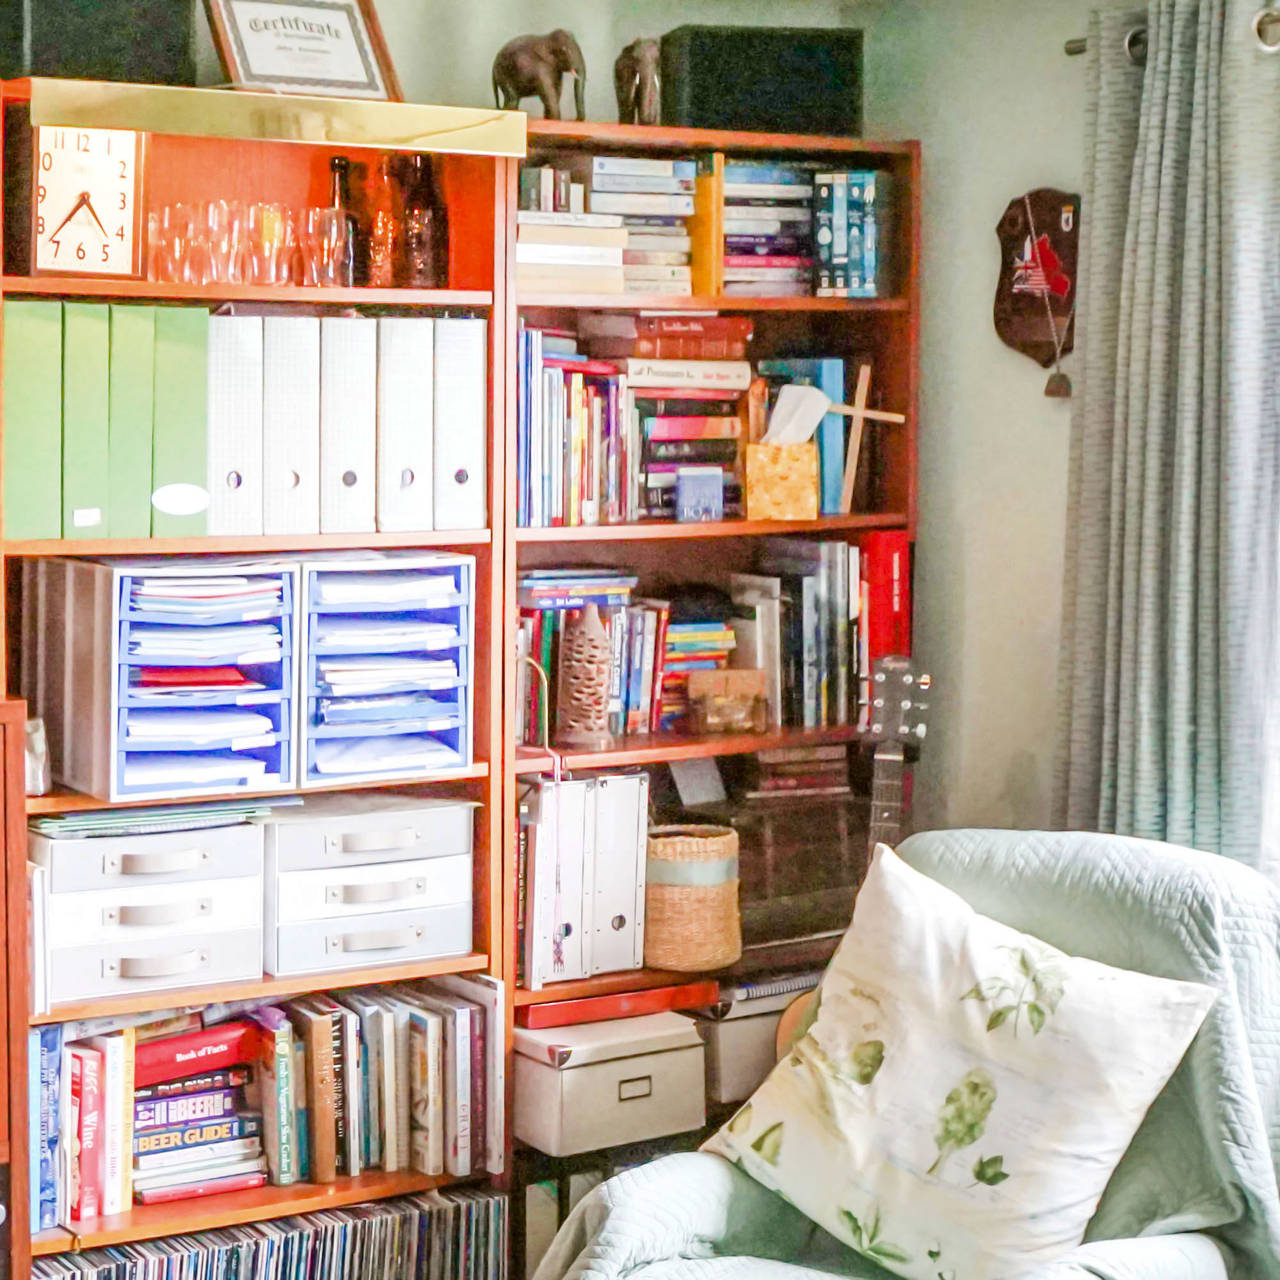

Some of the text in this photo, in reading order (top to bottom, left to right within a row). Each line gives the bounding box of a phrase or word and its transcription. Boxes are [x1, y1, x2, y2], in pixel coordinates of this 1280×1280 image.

[248, 15, 342, 39] Certificate
[54, 129, 65, 149] 11
[77, 132, 90, 152] 12
[119, 160, 127, 178] 2
[38, 185, 47, 204] 9
[119, 192, 126, 210] 3
[37, 216, 45, 235] 8
[115, 225, 125, 241] 4
[51, 239, 61, 258] 7
[76, 241, 86, 260] 6
[101, 244, 110, 262] 5
[175, 1050, 197, 1062] Book
[82, 1110, 99, 1149] Wine
[138, 1122, 232, 1153] BEER GUIDE
